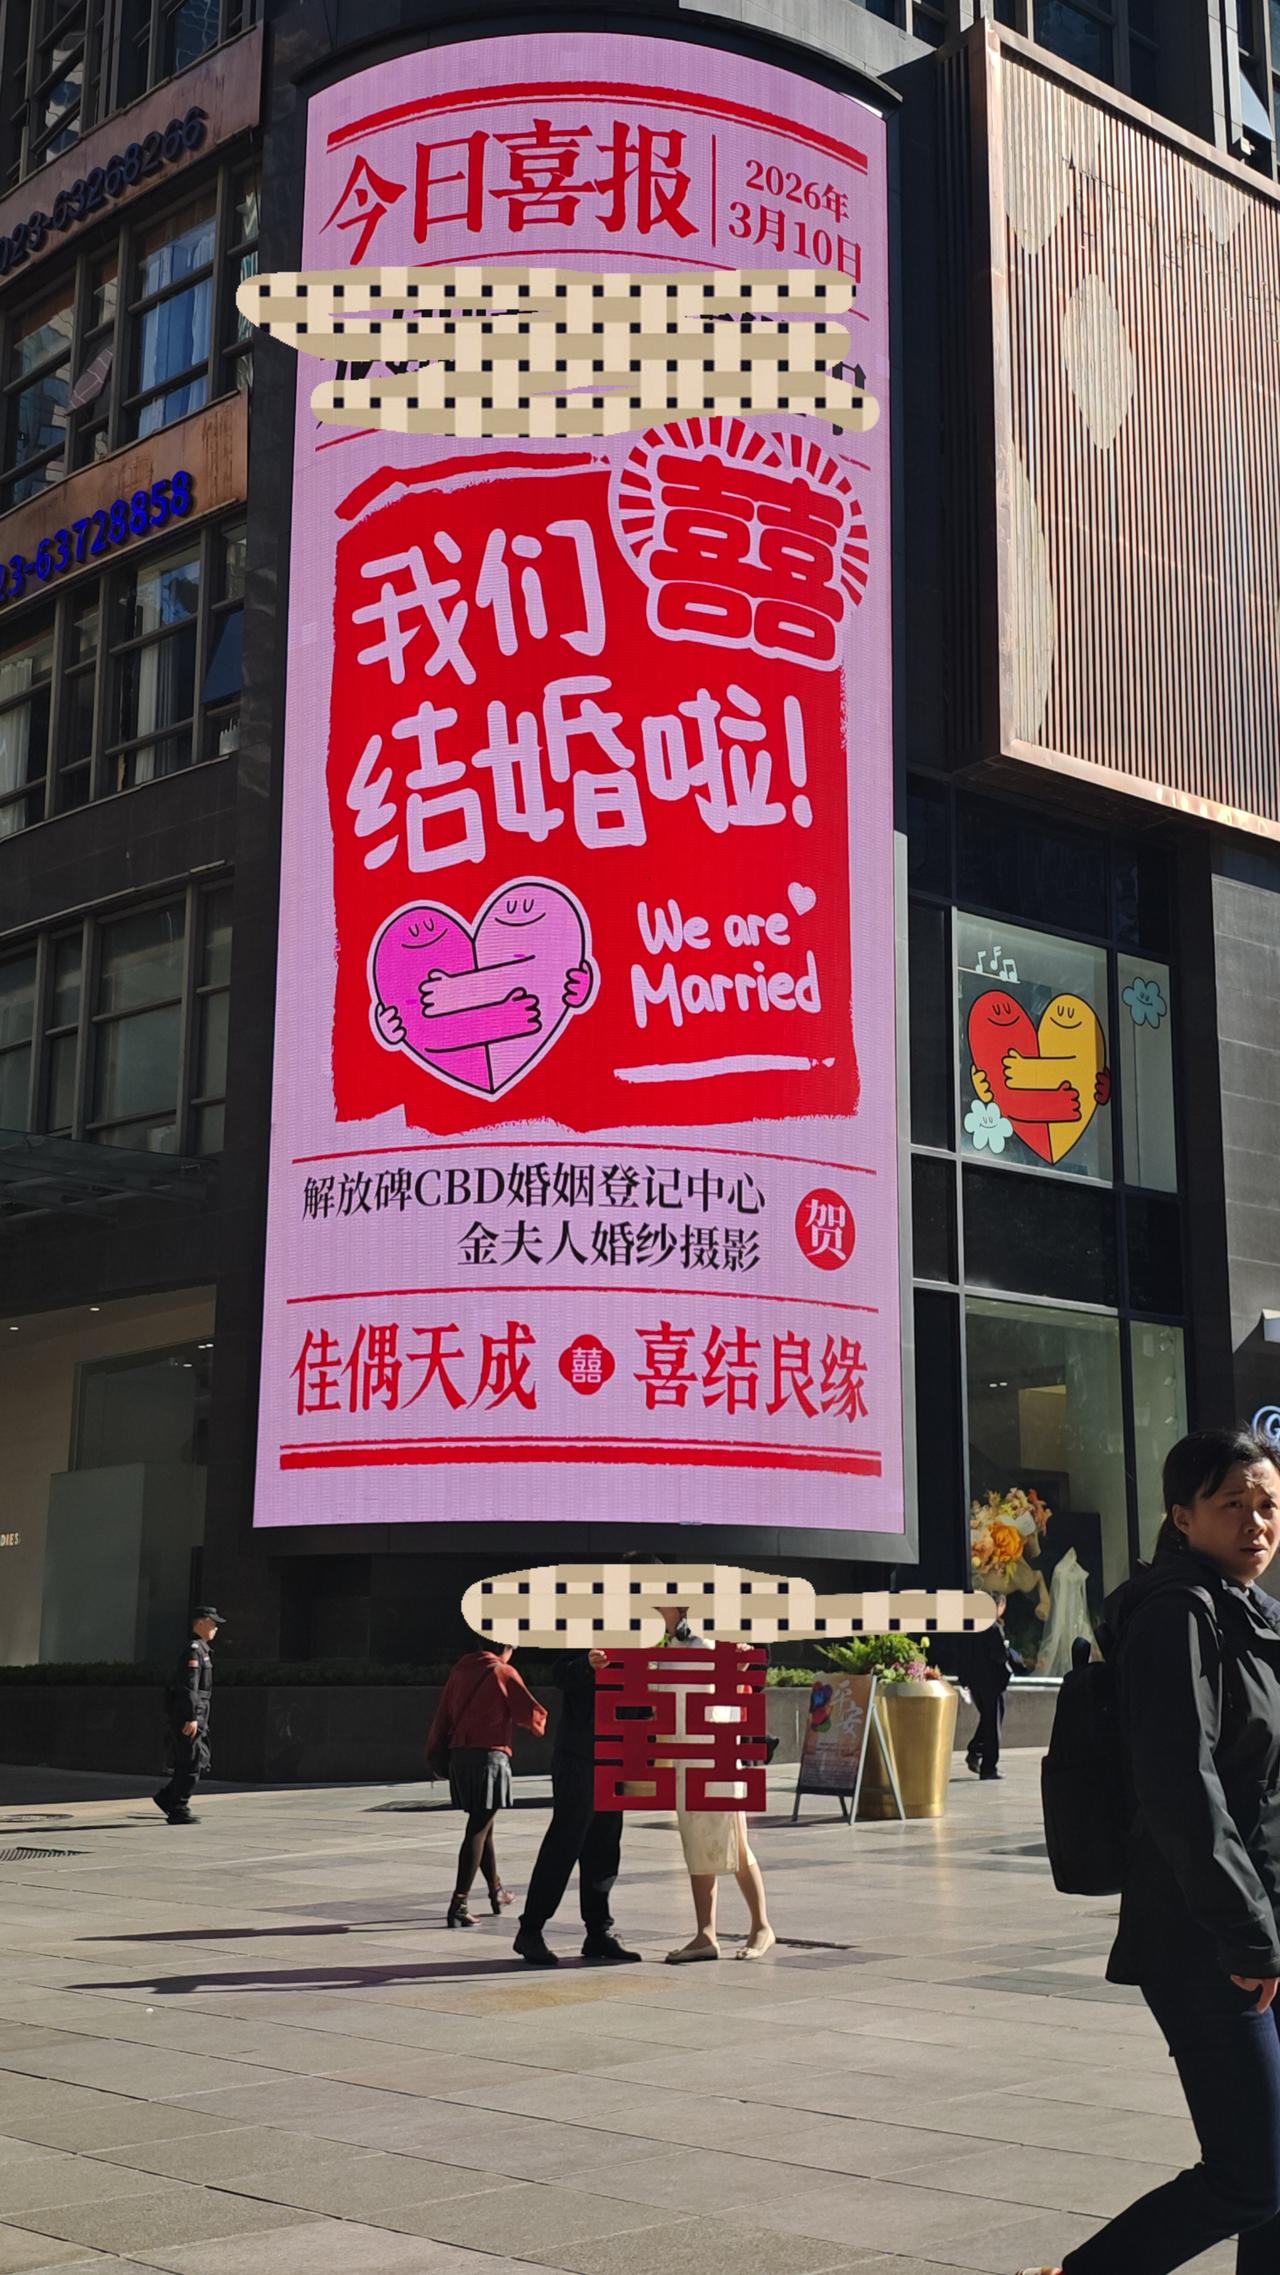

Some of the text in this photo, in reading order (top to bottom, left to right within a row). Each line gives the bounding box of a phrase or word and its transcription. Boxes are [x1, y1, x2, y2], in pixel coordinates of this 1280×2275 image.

[319, 119, 699, 265] 今日喜报
[745, 160, 849, 223] 2026年
[728, 201, 861, 283] 3月10日
[353, 519, 605, 685] 我们
[637, 899, 791, 955] We are
[631, 950, 821, 1028] Married
[302, 1162, 765, 1222] 解放碑CBD婚姻登记中心
[457, 1220, 760, 1272] 金夫人婚纱摄影
[805, 1198, 846, 1261] 贺
[289, 1320, 537, 1416] 佳偶天成
[633, 1320, 870, 1423] 喜结良缘
